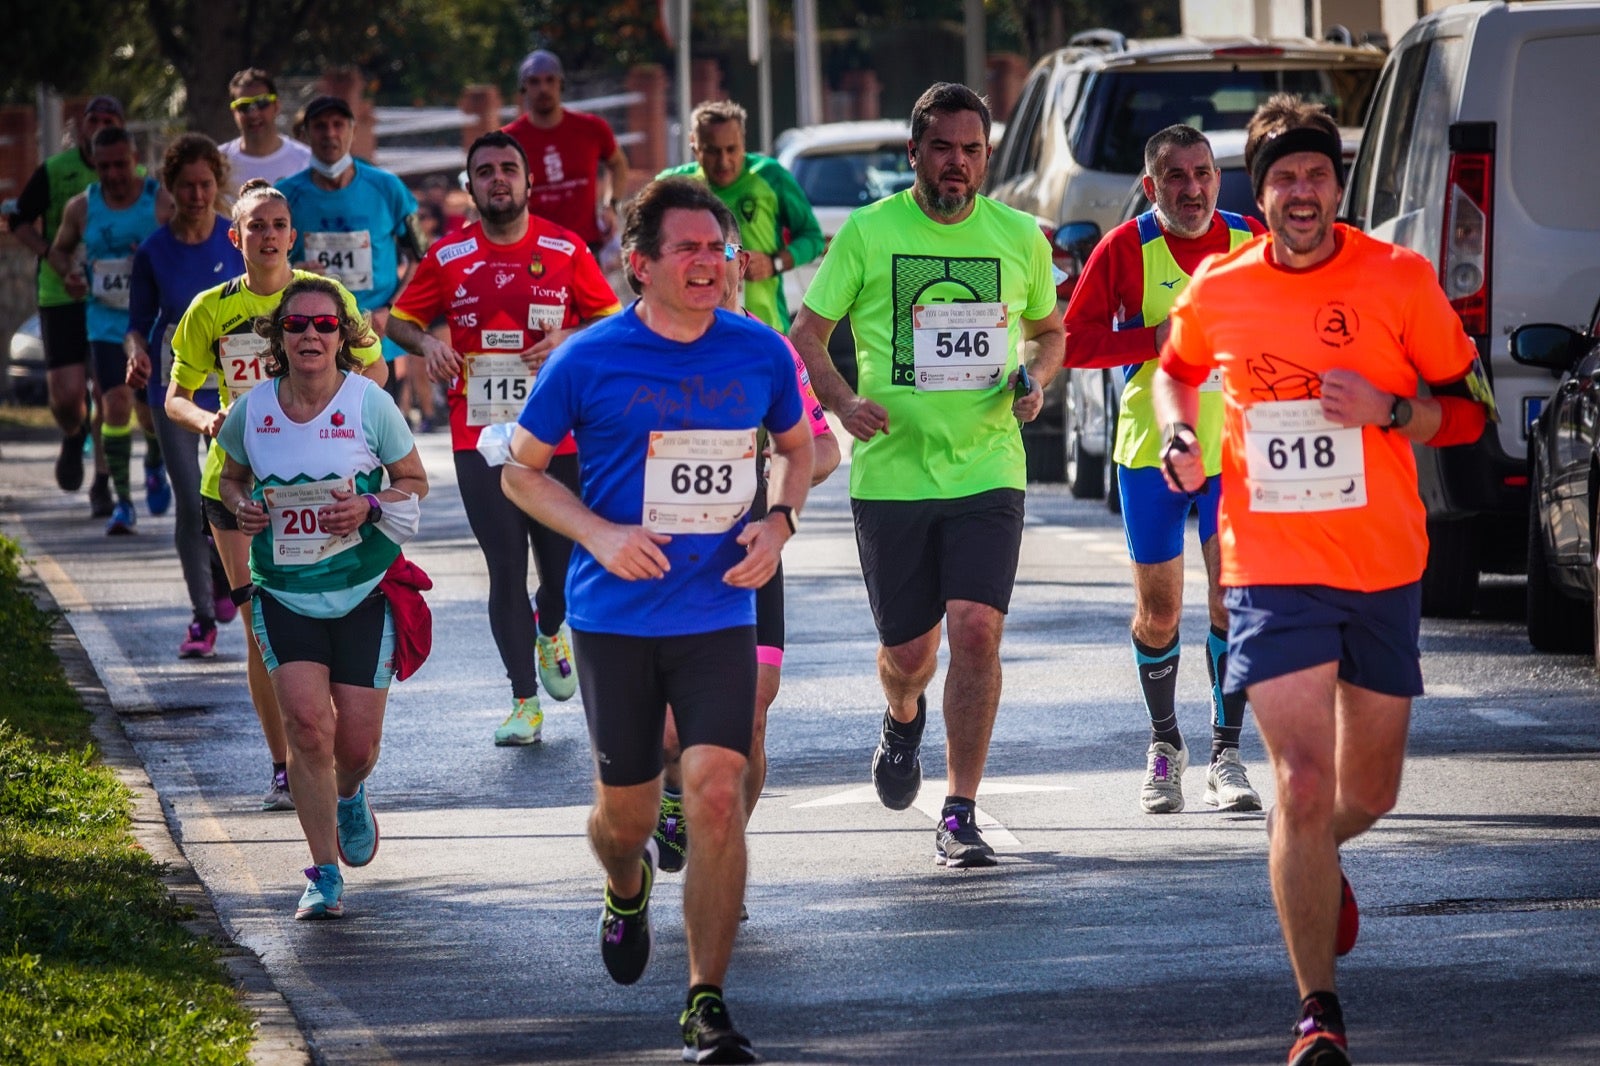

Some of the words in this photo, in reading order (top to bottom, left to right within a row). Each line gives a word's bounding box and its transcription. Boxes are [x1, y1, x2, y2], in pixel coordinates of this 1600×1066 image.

[318, 251, 354, 269] 641
[441, 244, 475, 261] MELILLA
[935, 331, 990, 358] 546
[484, 379, 527, 400] 115
[331, 429, 356, 439] GARNATA
[1268, 435, 1336, 470] 618
[671, 463, 732, 494] 683
